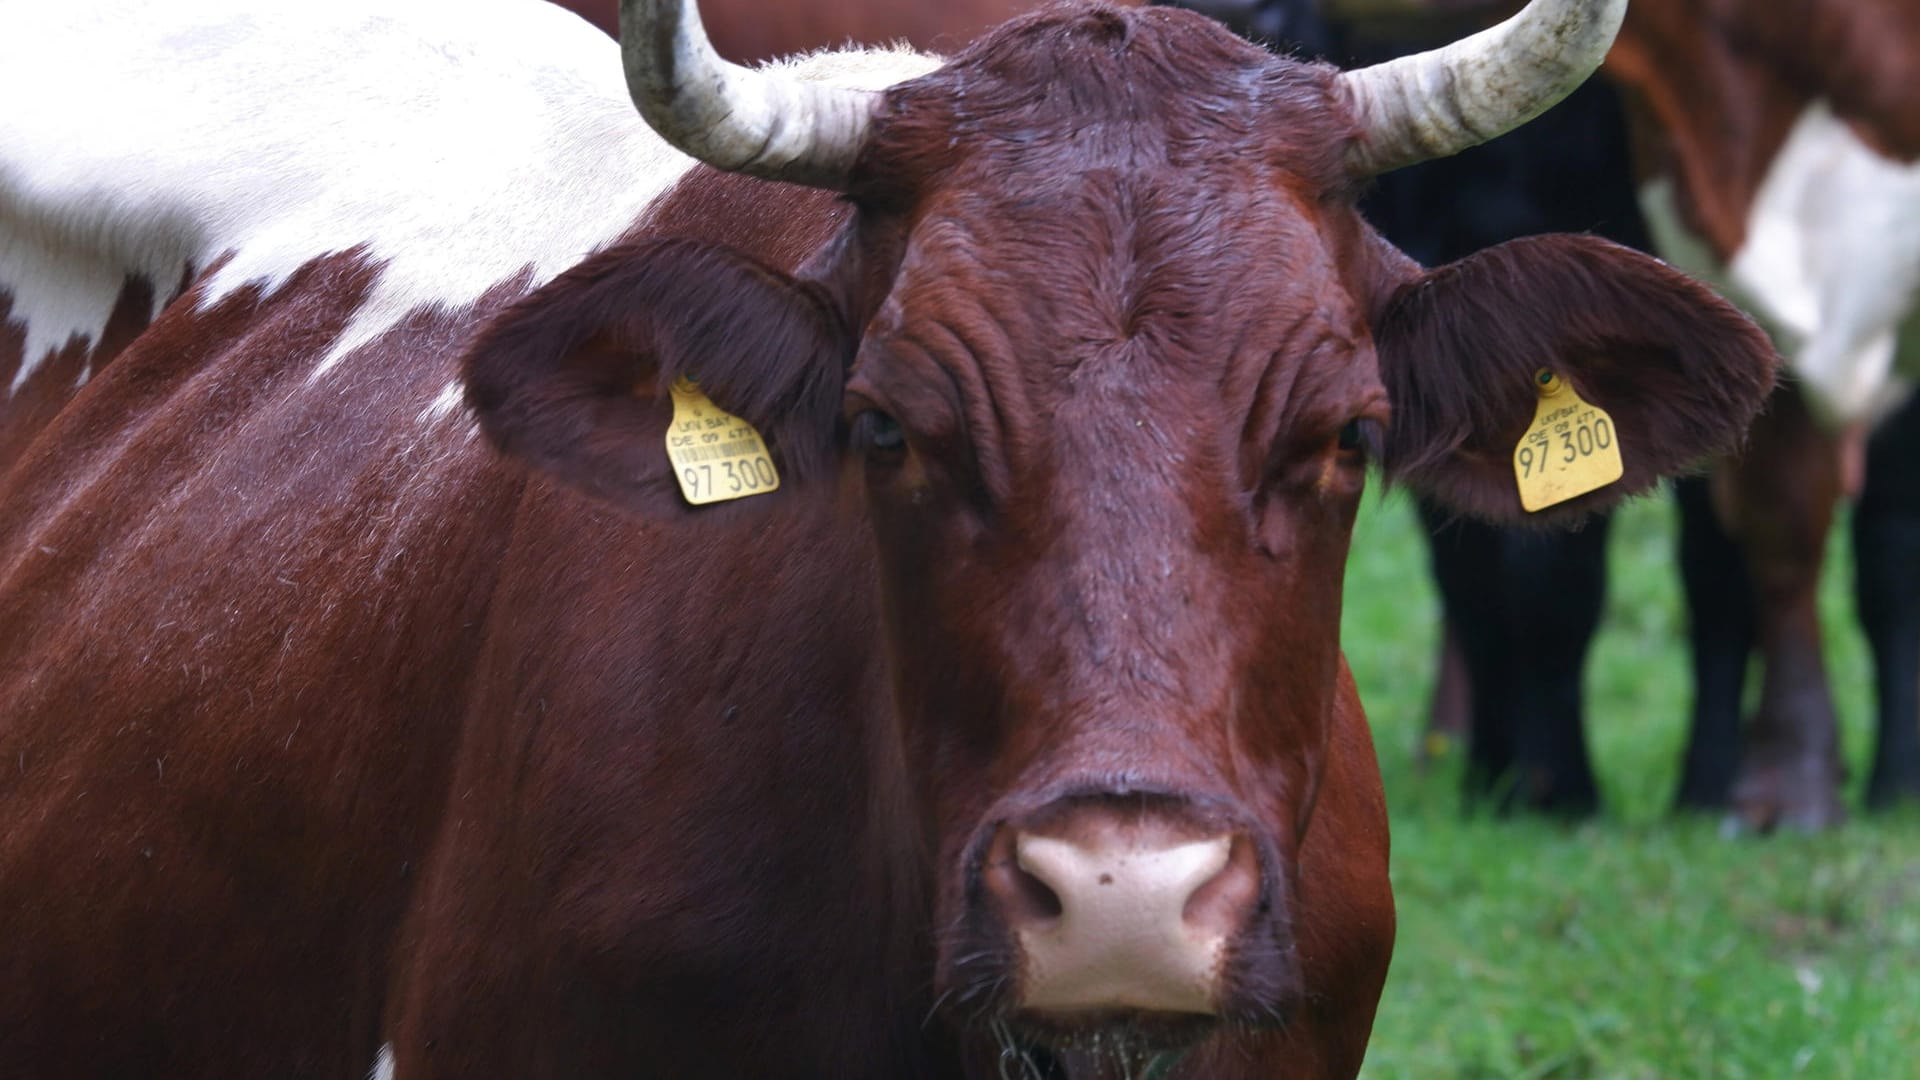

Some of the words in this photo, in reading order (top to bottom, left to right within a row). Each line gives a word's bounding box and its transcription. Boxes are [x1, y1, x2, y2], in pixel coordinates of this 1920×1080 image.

[671, 436, 694, 446] DE
[1518, 440, 1549, 478] 97
[1560, 418, 1610, 462] 300
[1528, 429, 1547, 443] DE
[684, 465, 712, 498] 97
[721, 457, 774, 492] 300
